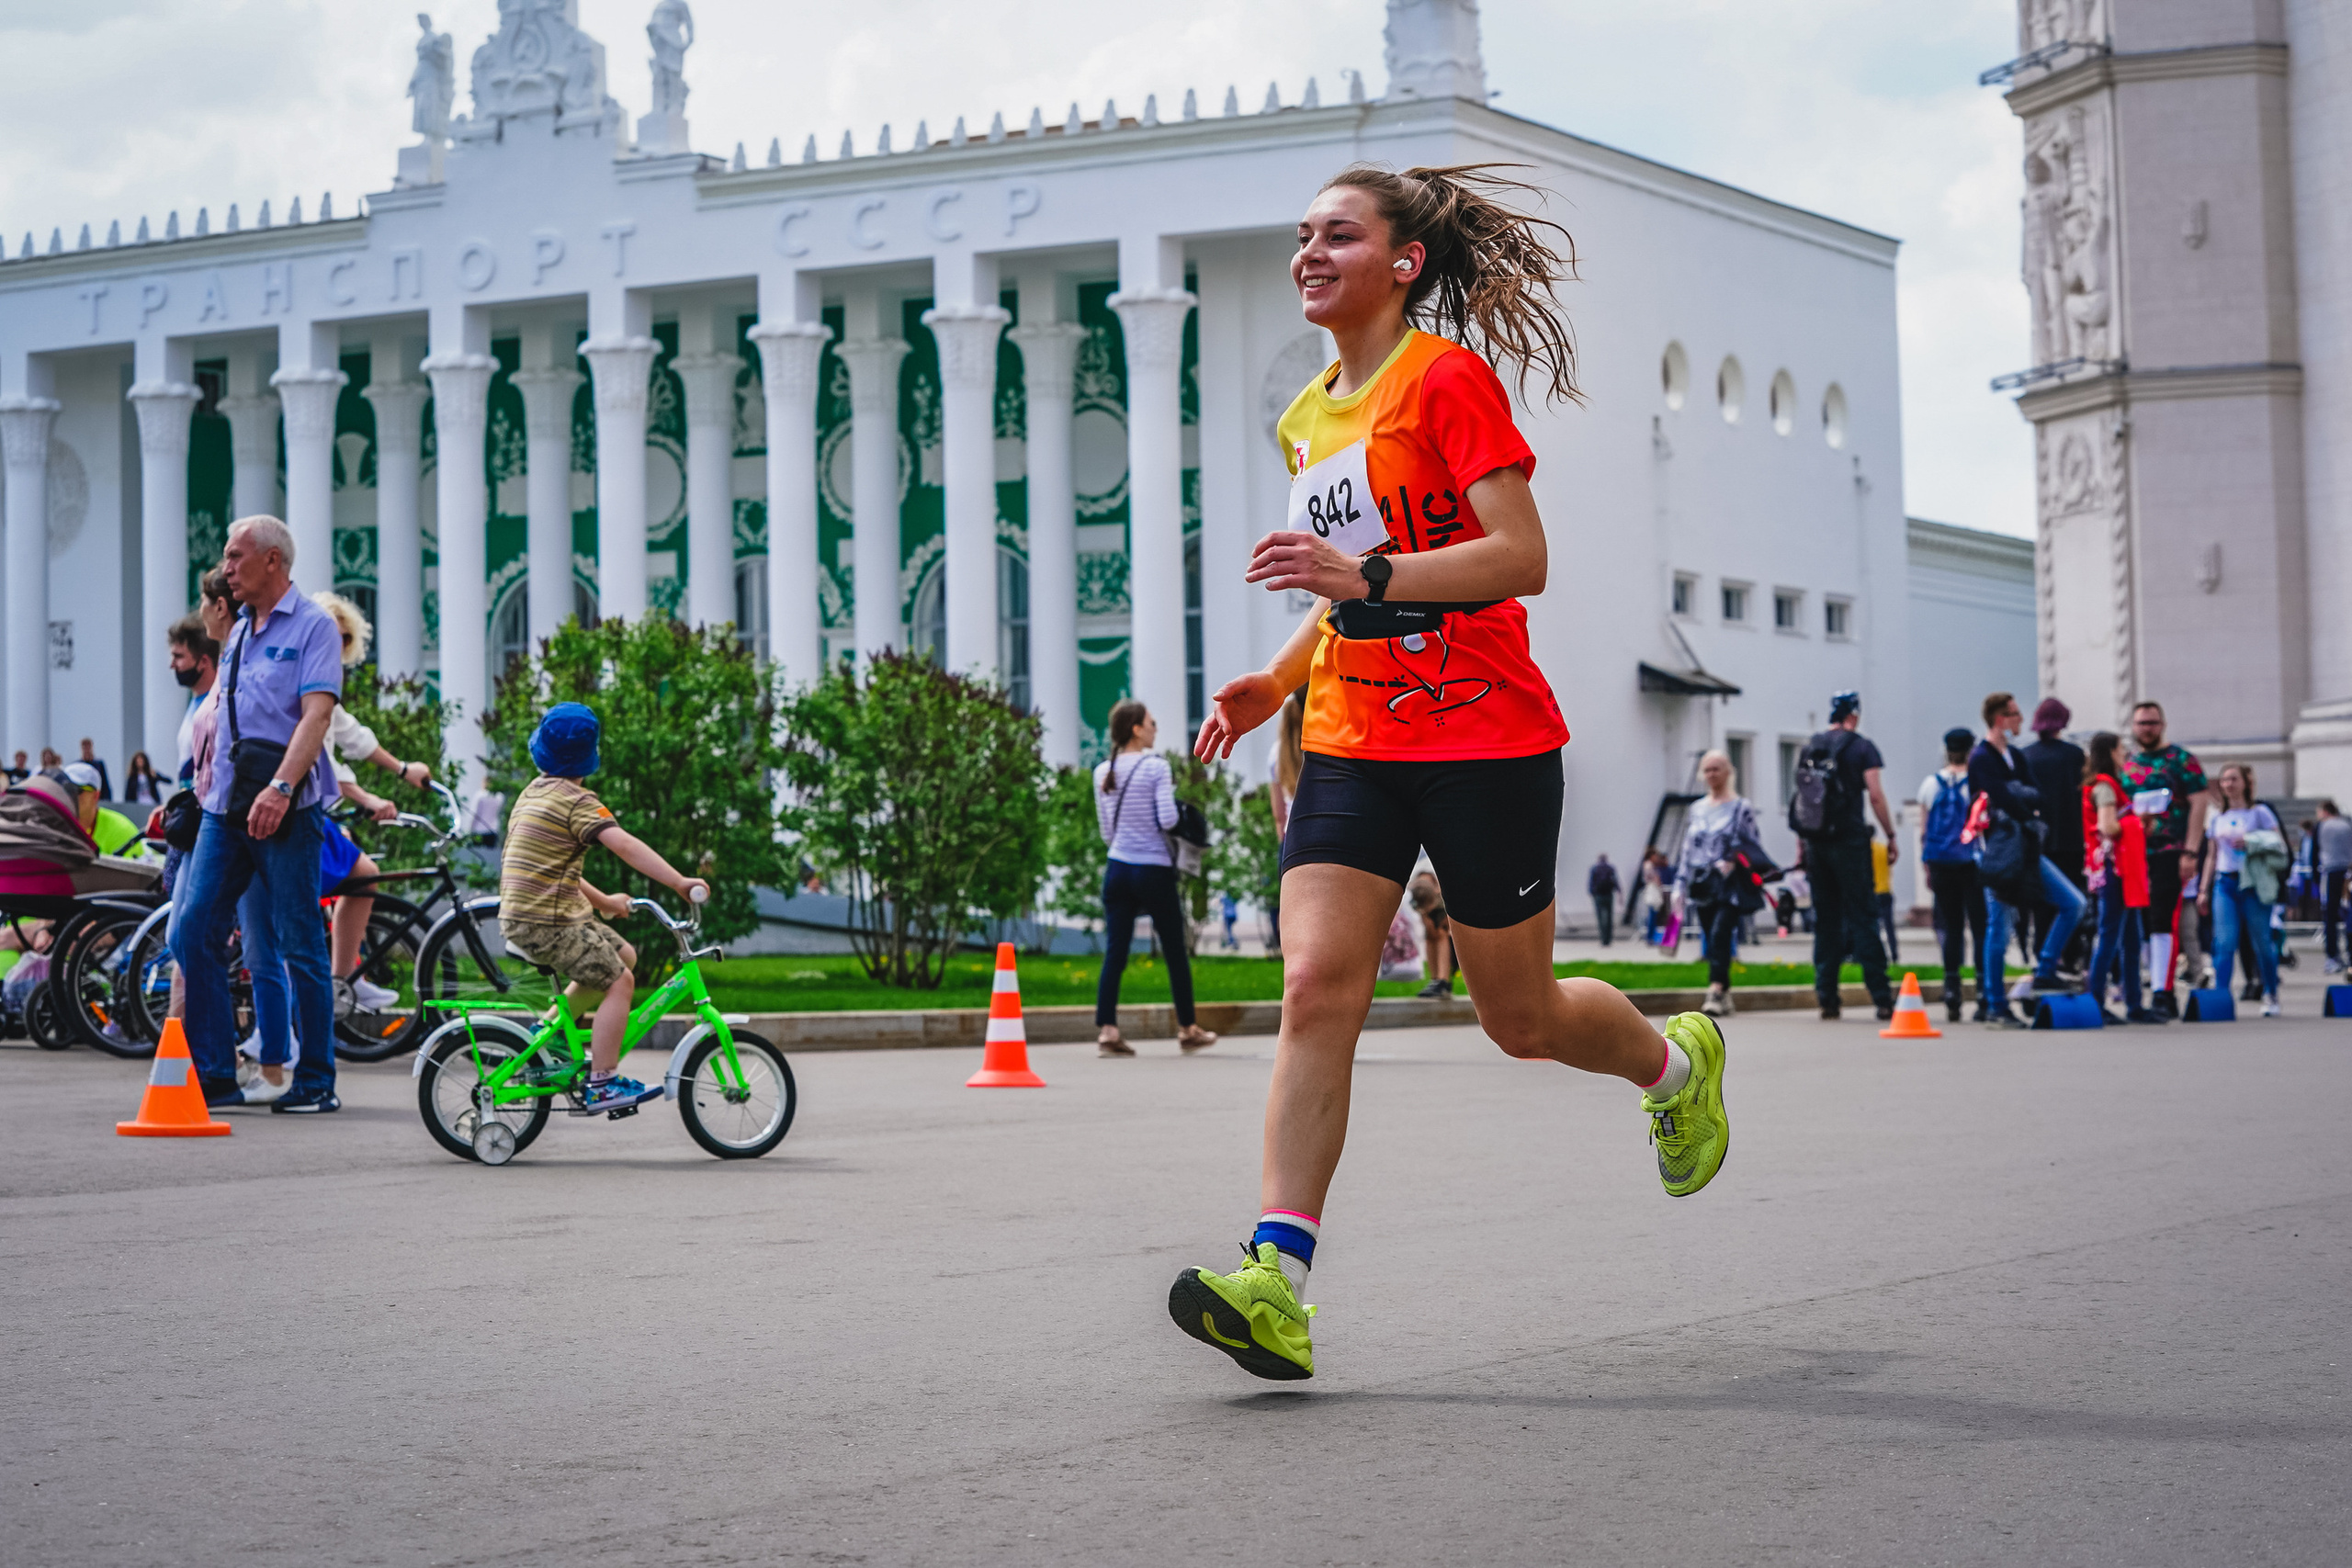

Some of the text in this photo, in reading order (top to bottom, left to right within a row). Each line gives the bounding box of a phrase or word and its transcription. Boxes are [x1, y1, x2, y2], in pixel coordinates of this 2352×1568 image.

[78, 181, 1043, 335] ТРАНСПОРТ СССР
[1308, 477, 1362, 537] 842
